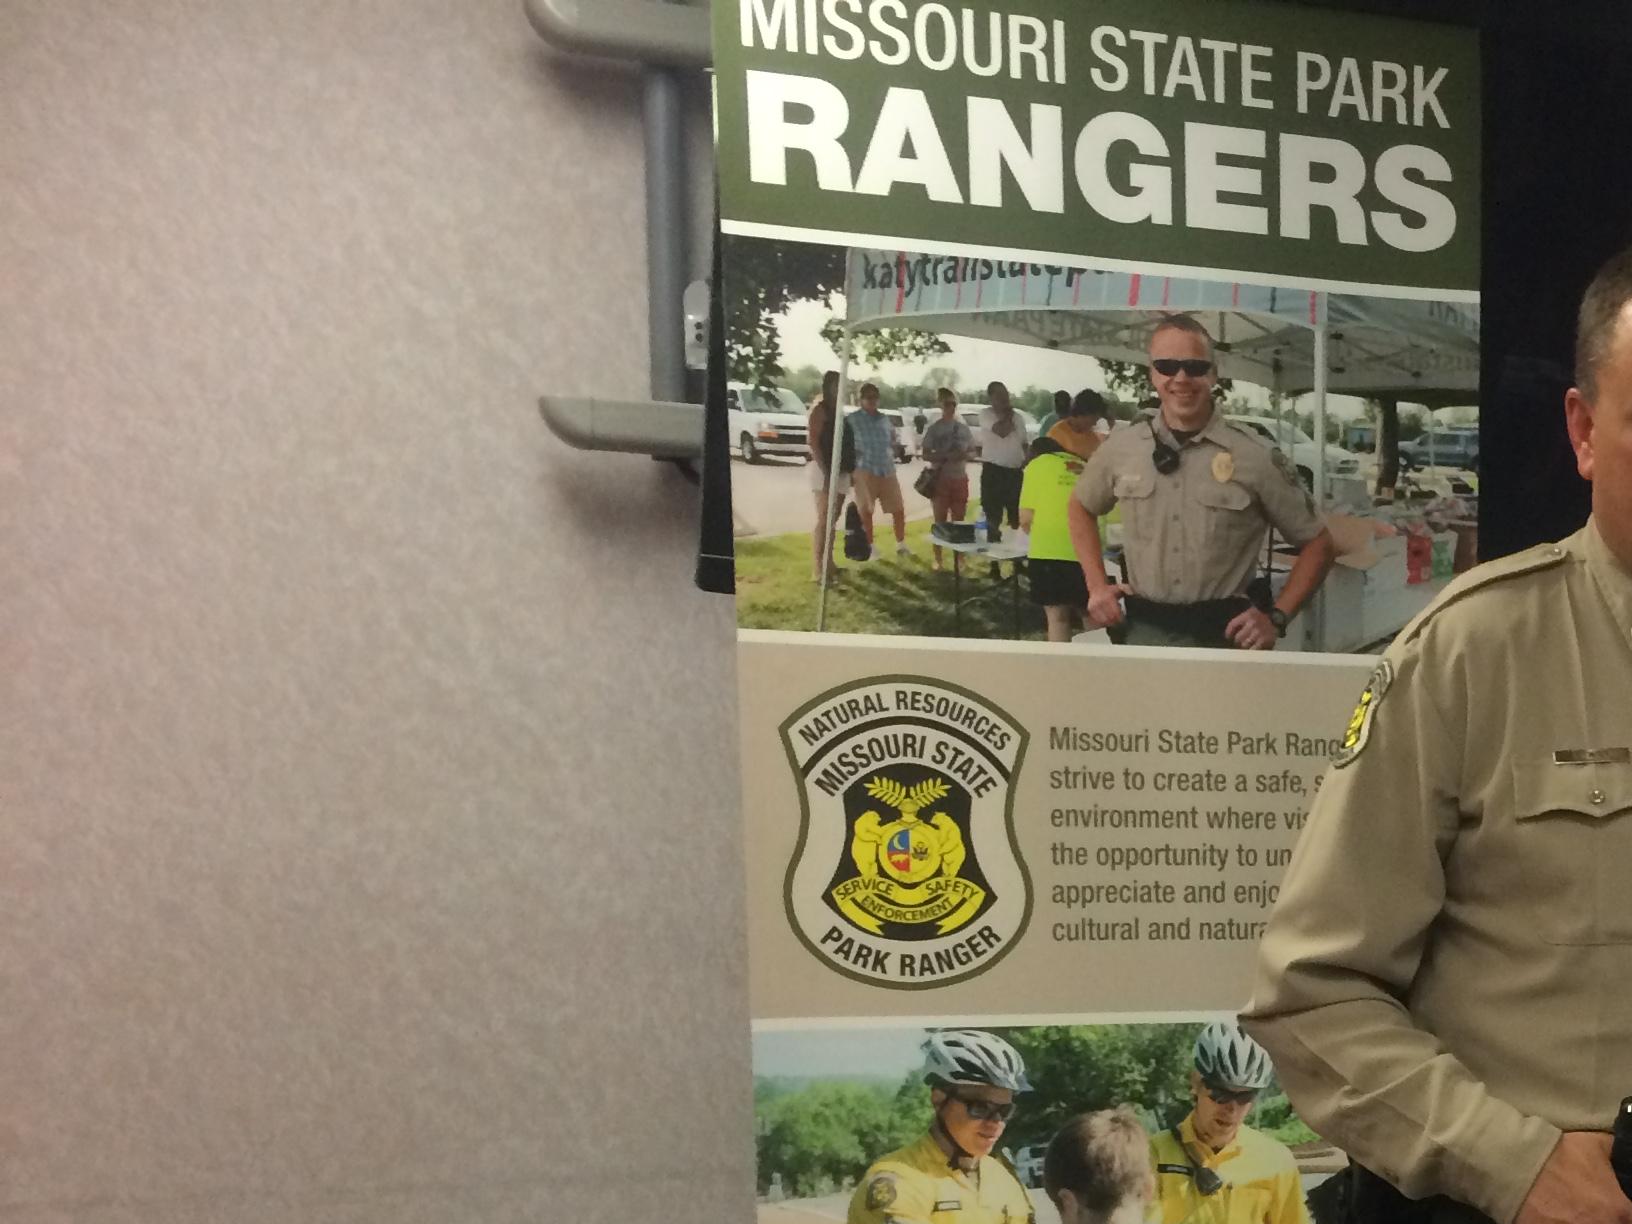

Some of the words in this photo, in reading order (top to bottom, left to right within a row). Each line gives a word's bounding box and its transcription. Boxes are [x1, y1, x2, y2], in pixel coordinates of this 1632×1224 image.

[739, 0, 1067, 85] MISSOURI
[1090, 25, 1274, 110] STATE
[1297, 52, 1450, 130] PARK
[745, 69, 1457, 254] RANGERS
[798, 692, 889, 747] NATURAL
[895, 690, 1012, 752] RESOURCES
[1050, 726, 1149, 753] Missouri
[1158, 729, 1218, 755] State
[1227, 731, 1278, 756] Park
[814, 733, 927, 797] MISSOURI
[932, 740, 998, 799] STATE
[1050, 765, 1115, 790] strive
[1123, 766, 1145, 791] to
[1153, 769, 1227, 793] create
[1234, 773, 1248, 793] a
[1255, 769, 1307, 797] safe,
[1050, 804, 1199, 829] environment
[1206, 806, 1276, 830] where
[1051, 842, 1088, 866] the
[1096, 843, 1229, 872] opportunity
[1237, 845, 1258, 867] to
[1266, 848, 1293, 867] un
[836, 878, 894, 900] SERVICE
[926, 879, 980, 899] SAFETY
[1052, 880, 1176, 909] appreciate
[1183, 880, 1226, 904] and
[861, 896, 954, 921] ENFORCEMENT
[1052, 917, 1139, 942] cultural
[1148, 918, 1191, 941] and
[820, 925, 889, 974] PARK
[900, 925, 1002, 977] RANGER
